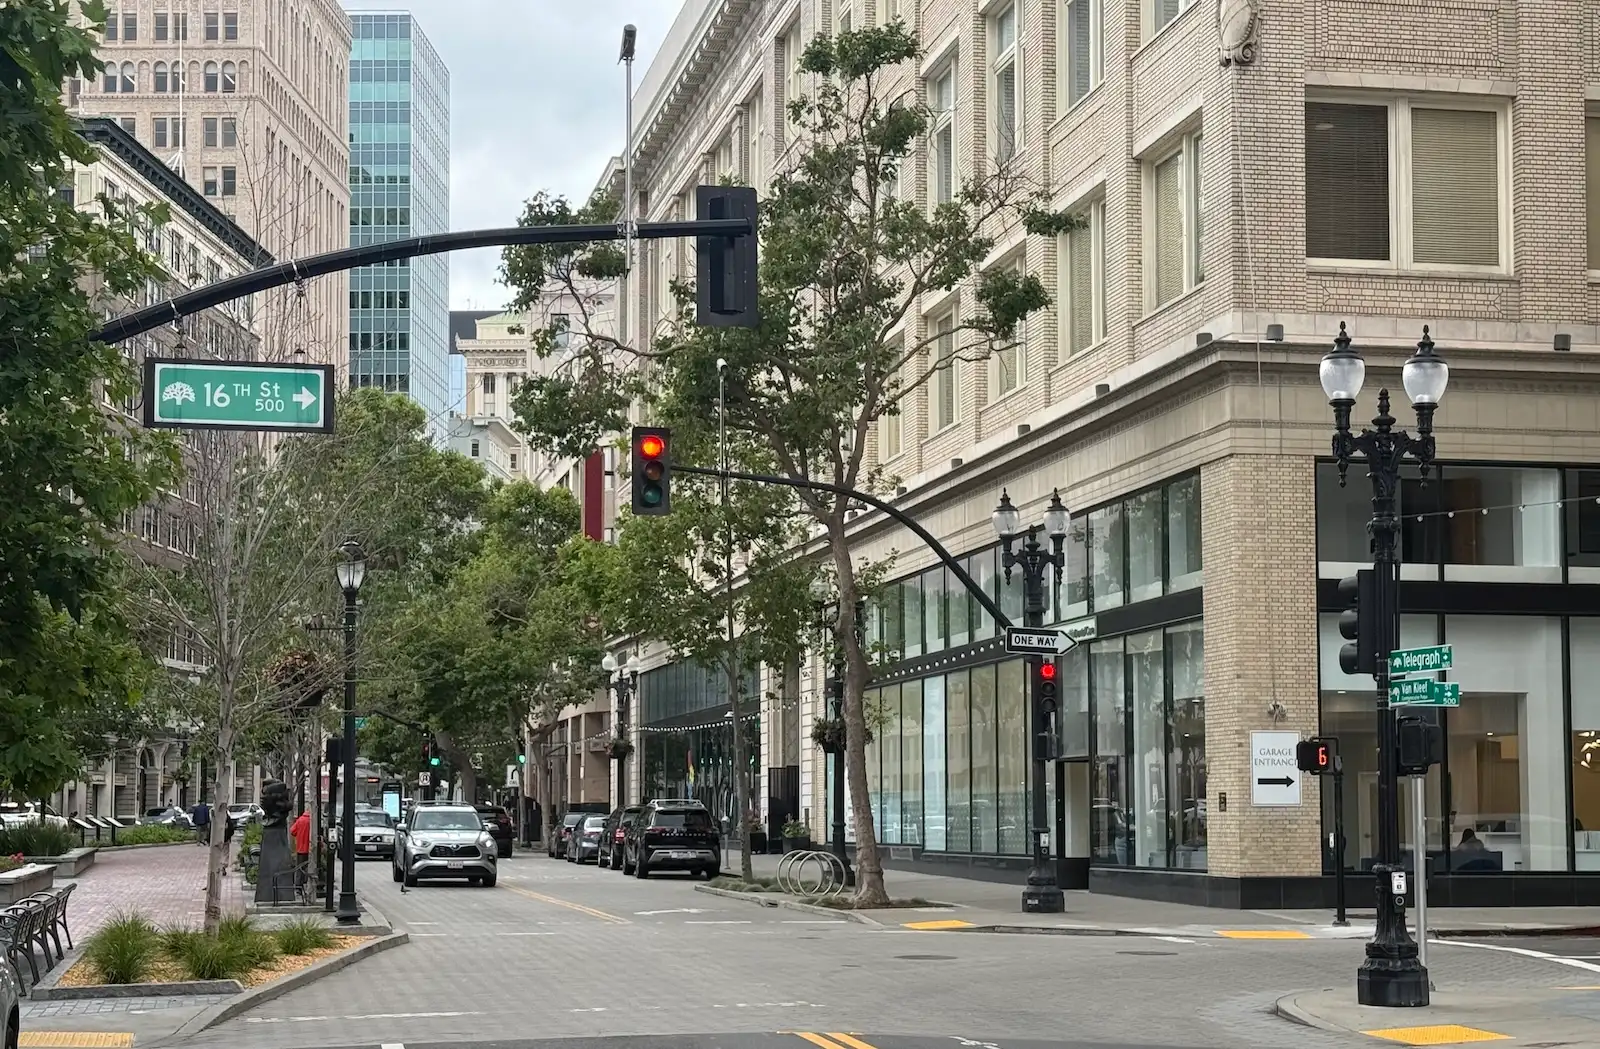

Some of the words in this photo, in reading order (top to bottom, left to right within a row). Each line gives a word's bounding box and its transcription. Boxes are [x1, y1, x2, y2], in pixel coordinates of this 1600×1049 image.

[260, 381, 281, 398] St
[255, 398, 284, 412] 500
[1014, 635, 1034, 645] ONE
[1036, 636, 1057, 647] WAY
[1402, 650, 1441, 670] Telegraph
[1401, 683, 1412, 694] Van
[1413, 681, 1428, 693] Kleef
[1259, 748, 1292, 756] GARAGE
[1318, 747, 1327, 765] 6
